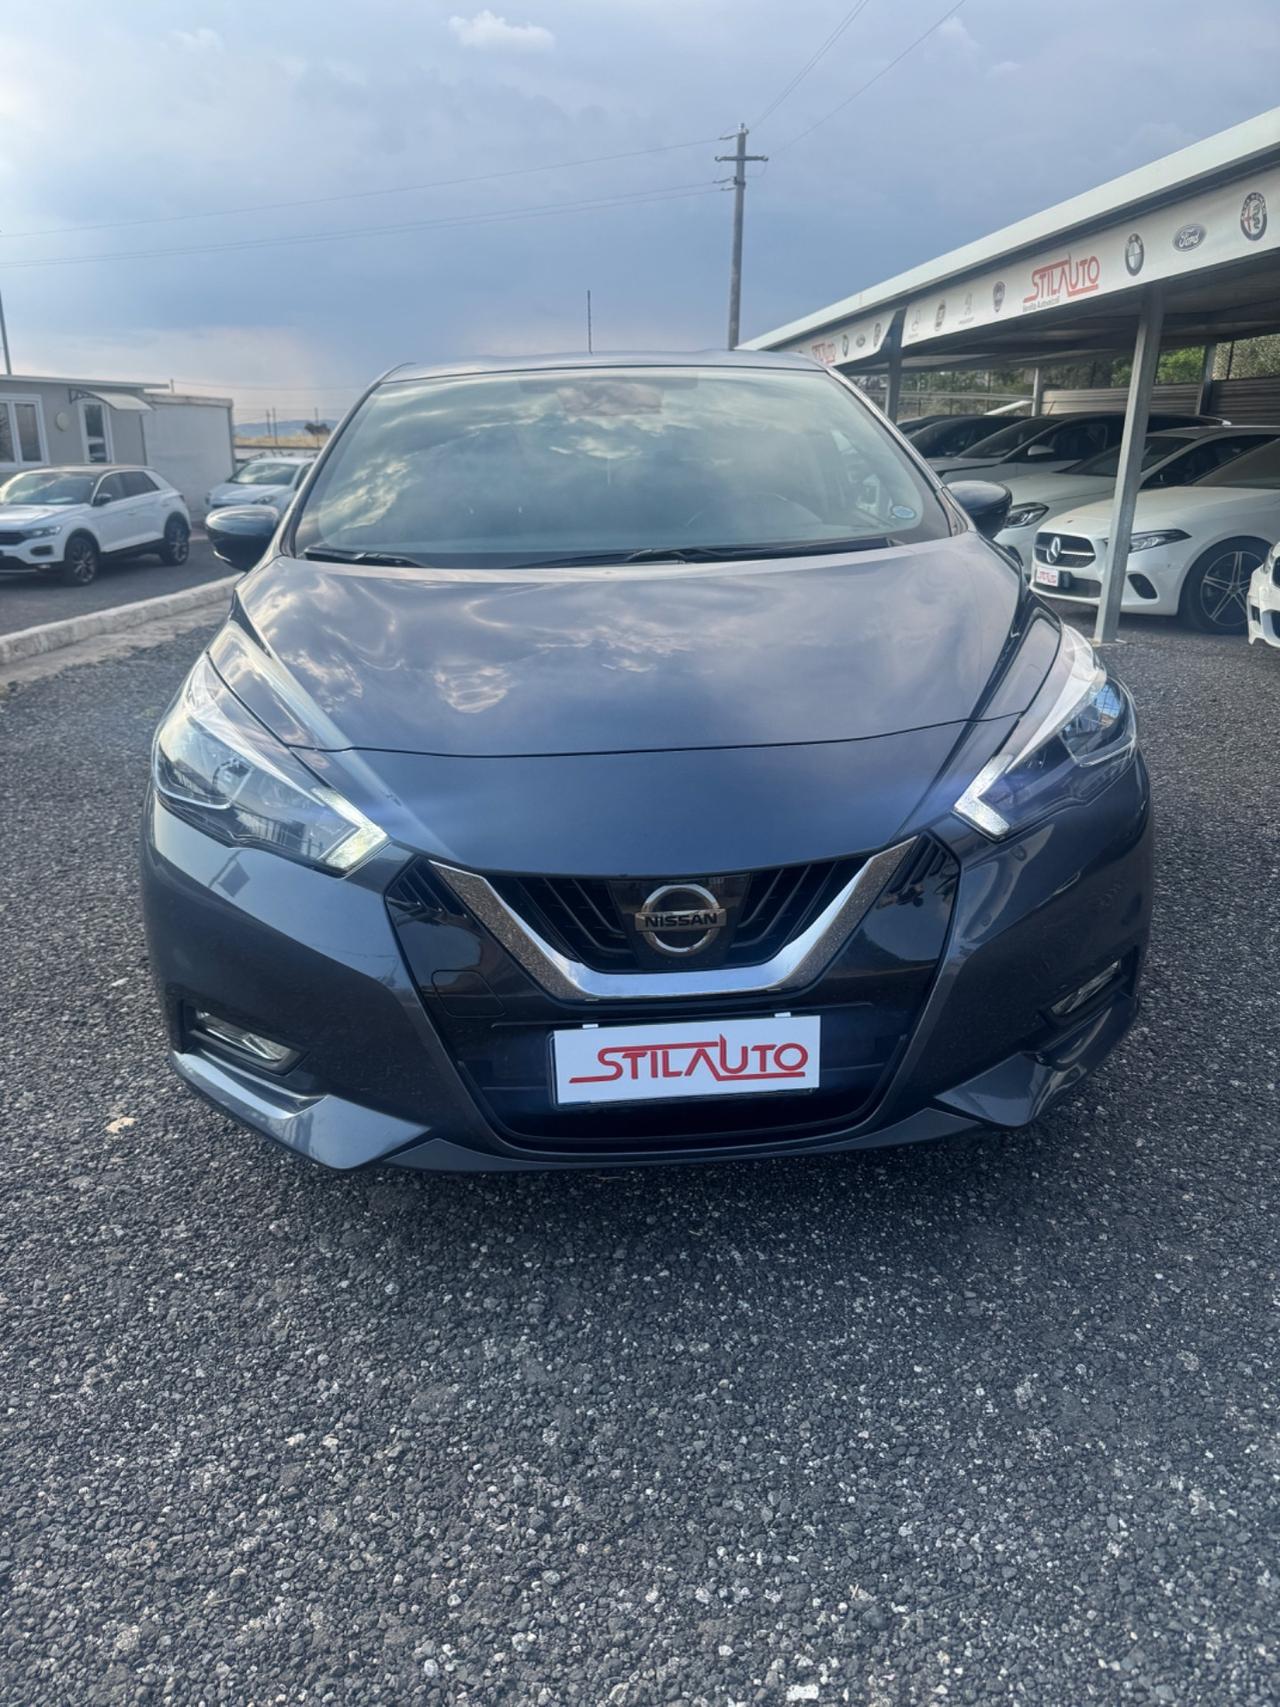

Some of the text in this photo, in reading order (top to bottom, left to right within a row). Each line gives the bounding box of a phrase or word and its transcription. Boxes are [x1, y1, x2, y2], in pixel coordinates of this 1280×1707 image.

[1023, 252, 1100, 303] STILAUTO
[644, 913, 717, 927] NISSAN
[569, 1033, 808, 1083] STILAUTO
